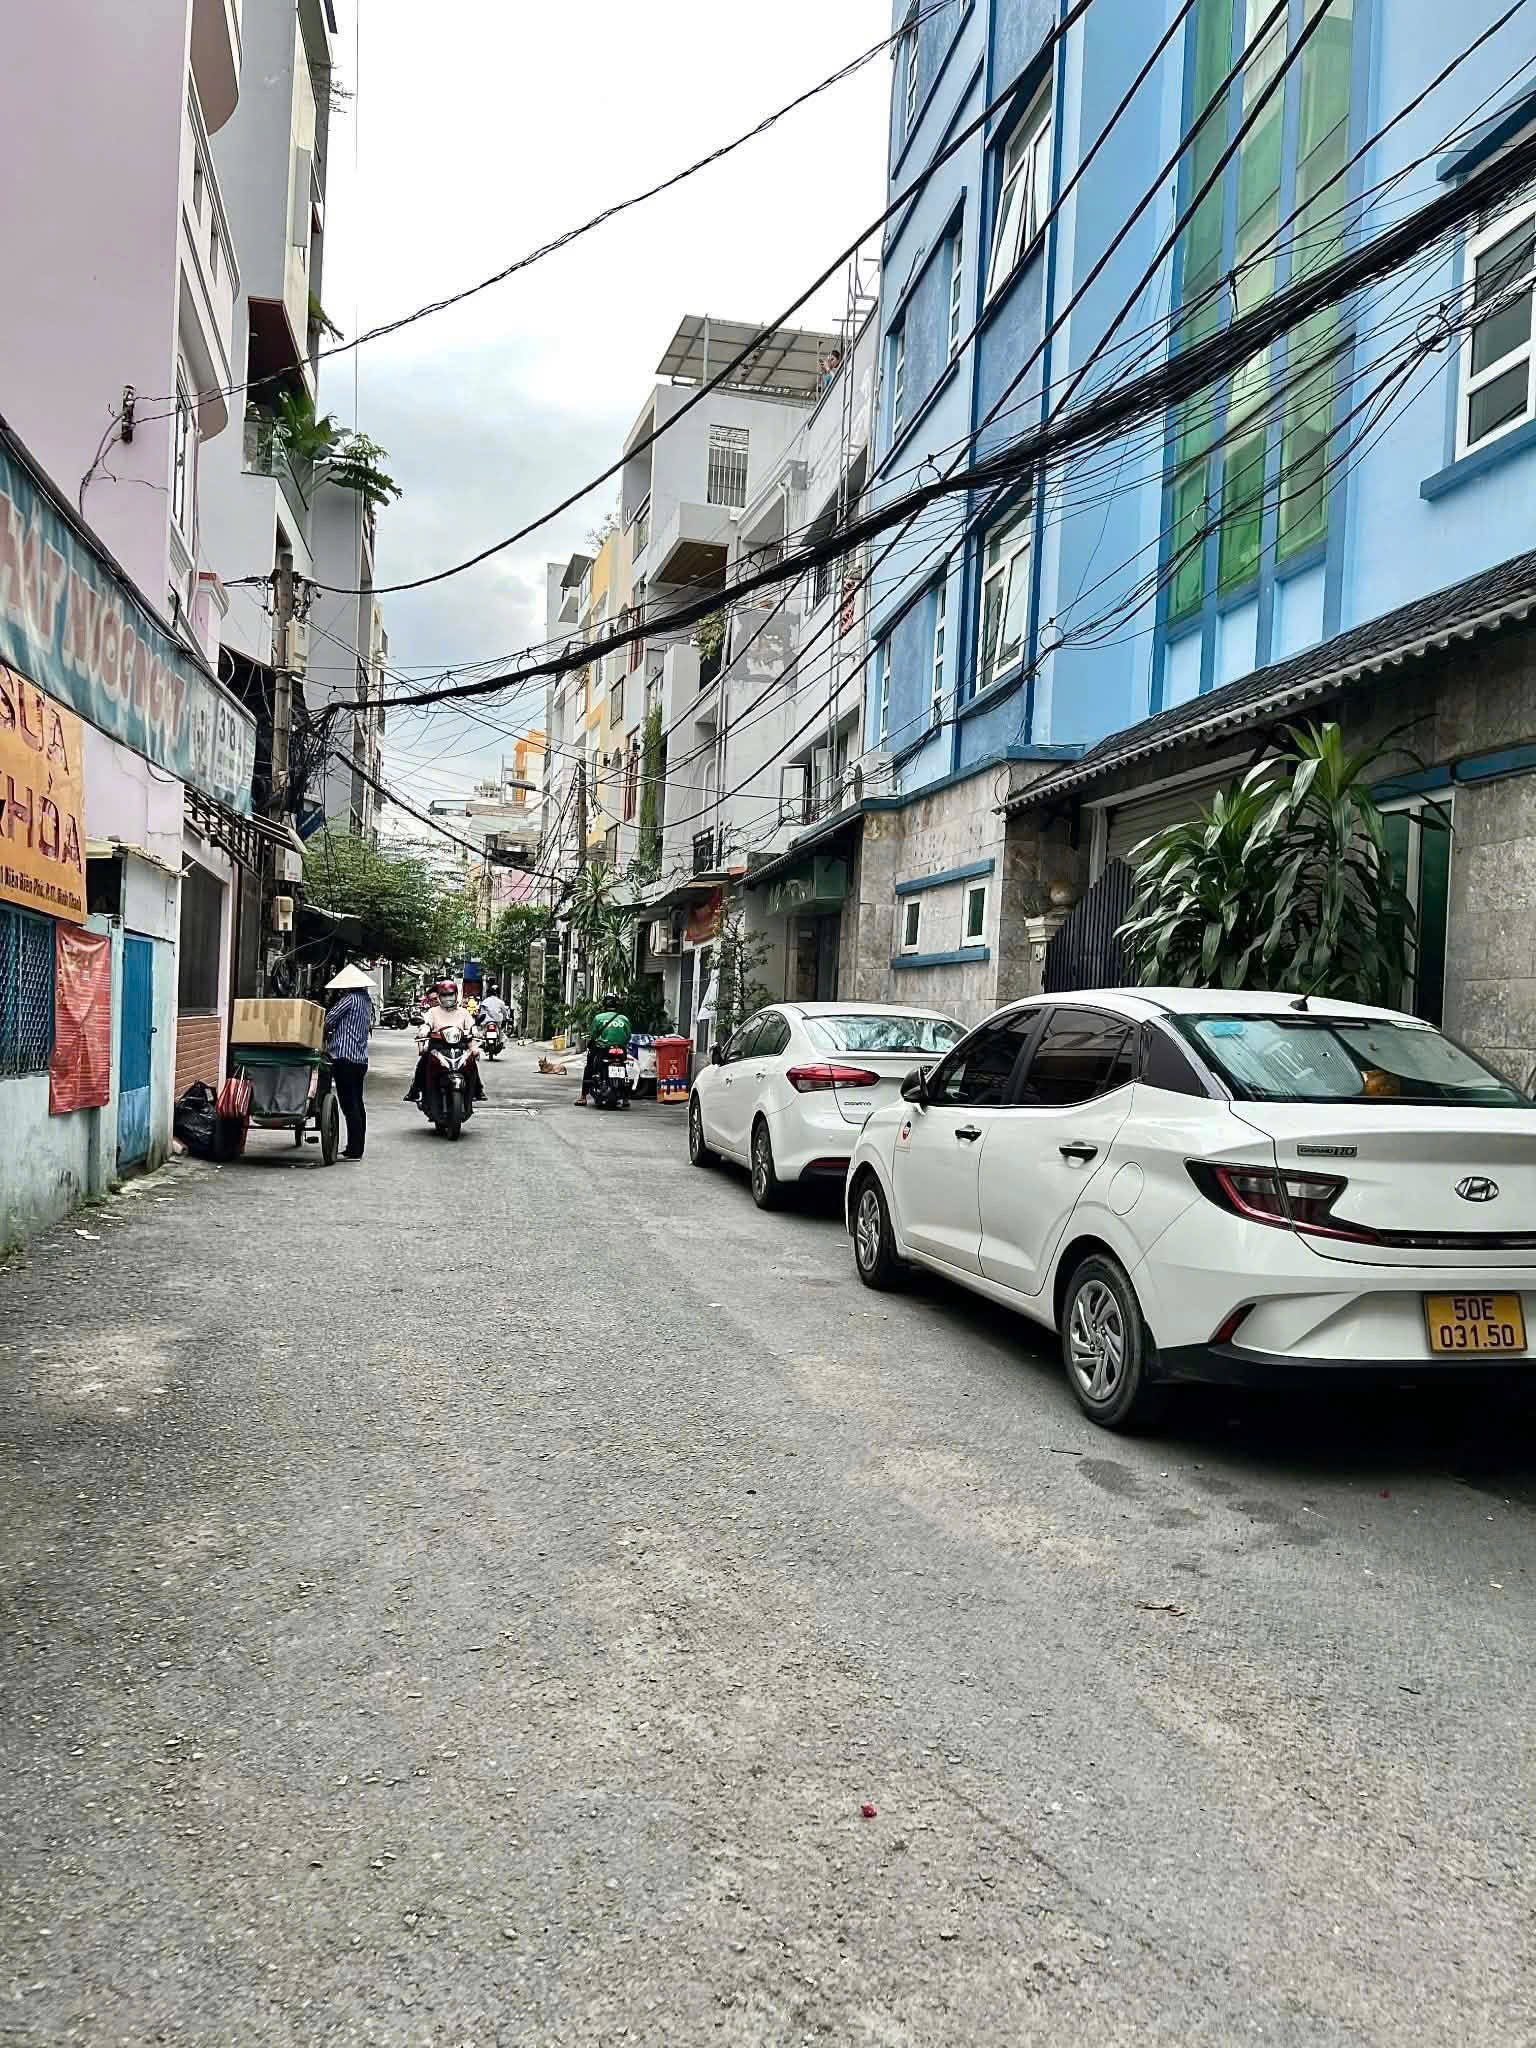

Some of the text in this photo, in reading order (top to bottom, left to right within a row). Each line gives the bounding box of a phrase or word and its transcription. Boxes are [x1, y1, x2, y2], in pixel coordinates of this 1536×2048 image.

[0, 769, 82, 874] HÓA
[1453, 1297, 1496, 1321] 50E
[1440, 1324, 1515, 1348] 031.50
